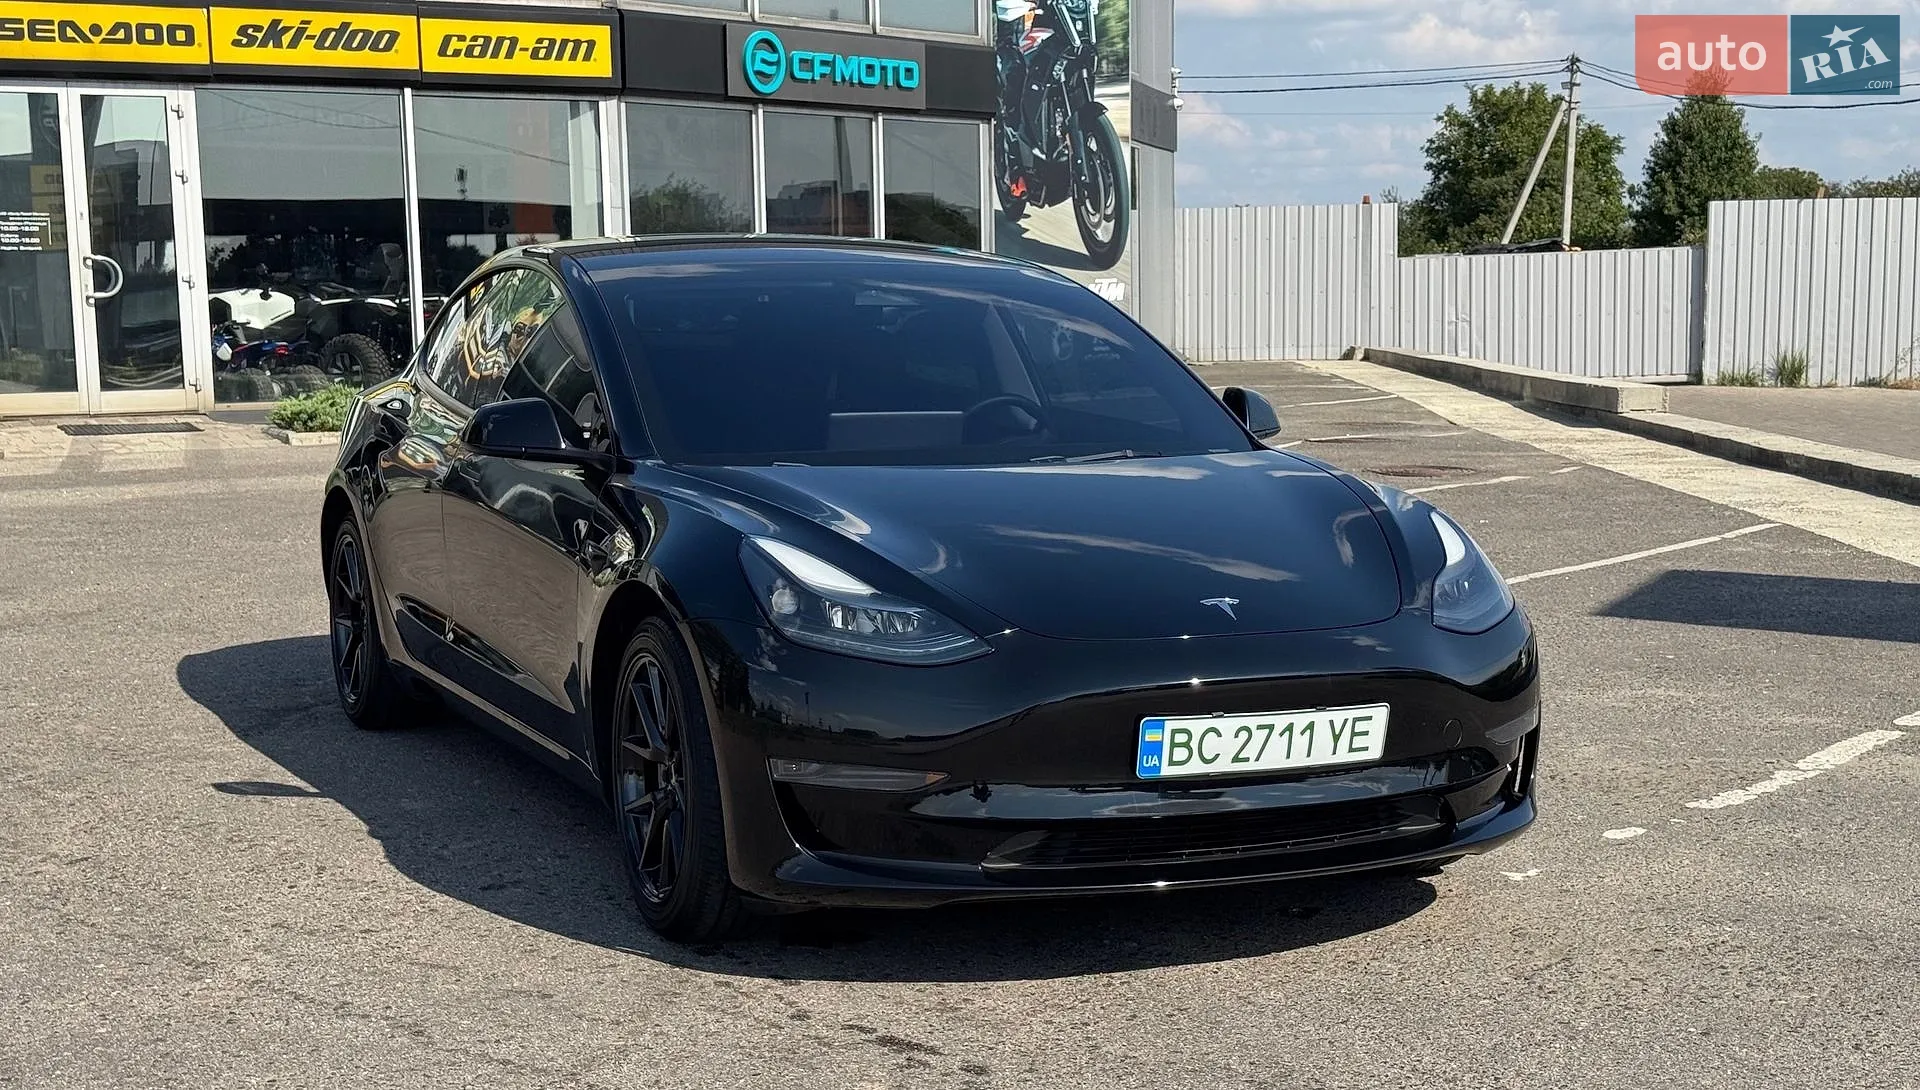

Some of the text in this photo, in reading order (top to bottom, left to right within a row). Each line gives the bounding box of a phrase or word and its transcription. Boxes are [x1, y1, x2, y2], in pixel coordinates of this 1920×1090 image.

[231, 19, 401, 53] ski-doo
[437, 34, 597, 62] can-am
[790, 50, 920, 89] CFMOTO
[1167, 715, 1373, 767] BC 2711 YE
[1143, 754, 1160, 767] UA
